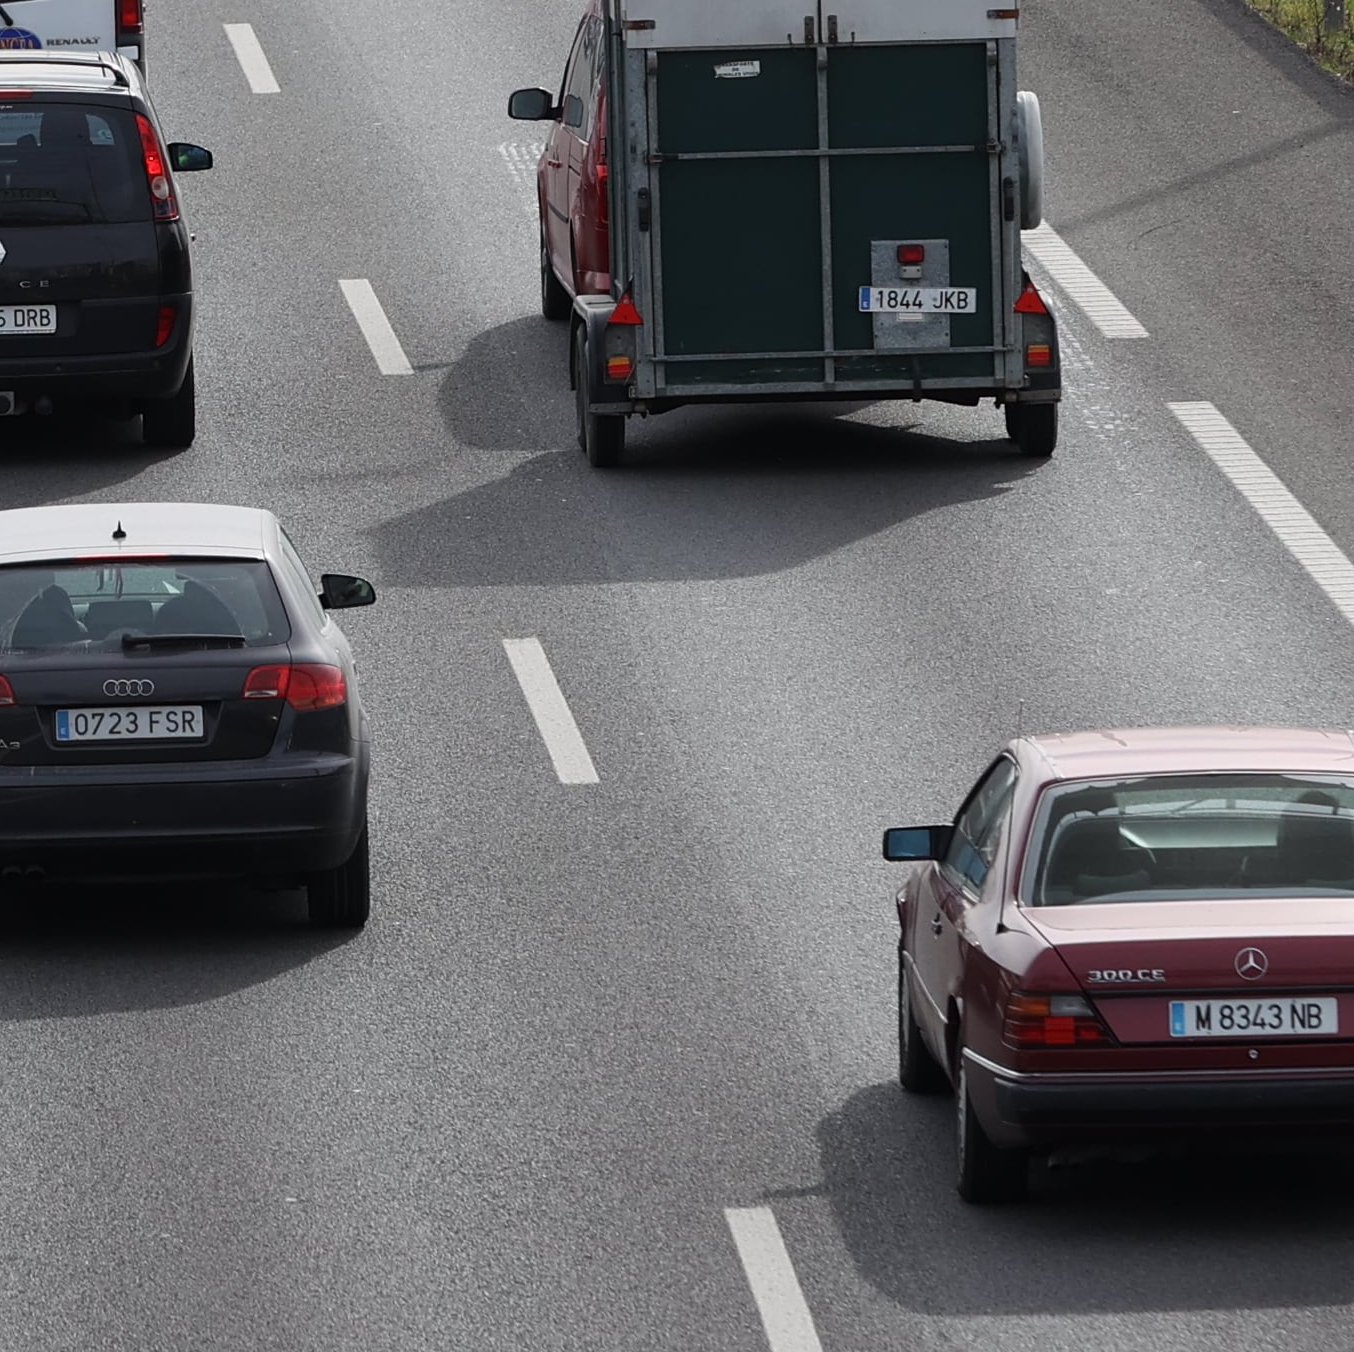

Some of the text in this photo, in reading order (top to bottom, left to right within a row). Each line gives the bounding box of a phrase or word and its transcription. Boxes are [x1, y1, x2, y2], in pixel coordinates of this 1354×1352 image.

[877, 290, 924, 309] 1844
[932, 290, 969, 310] JKB
[13, 308, 51, 327] DRB
[74, 710, 195, 736] 0723 FSR
[1195, 1002, 1322, 1031] M 8343 NB
